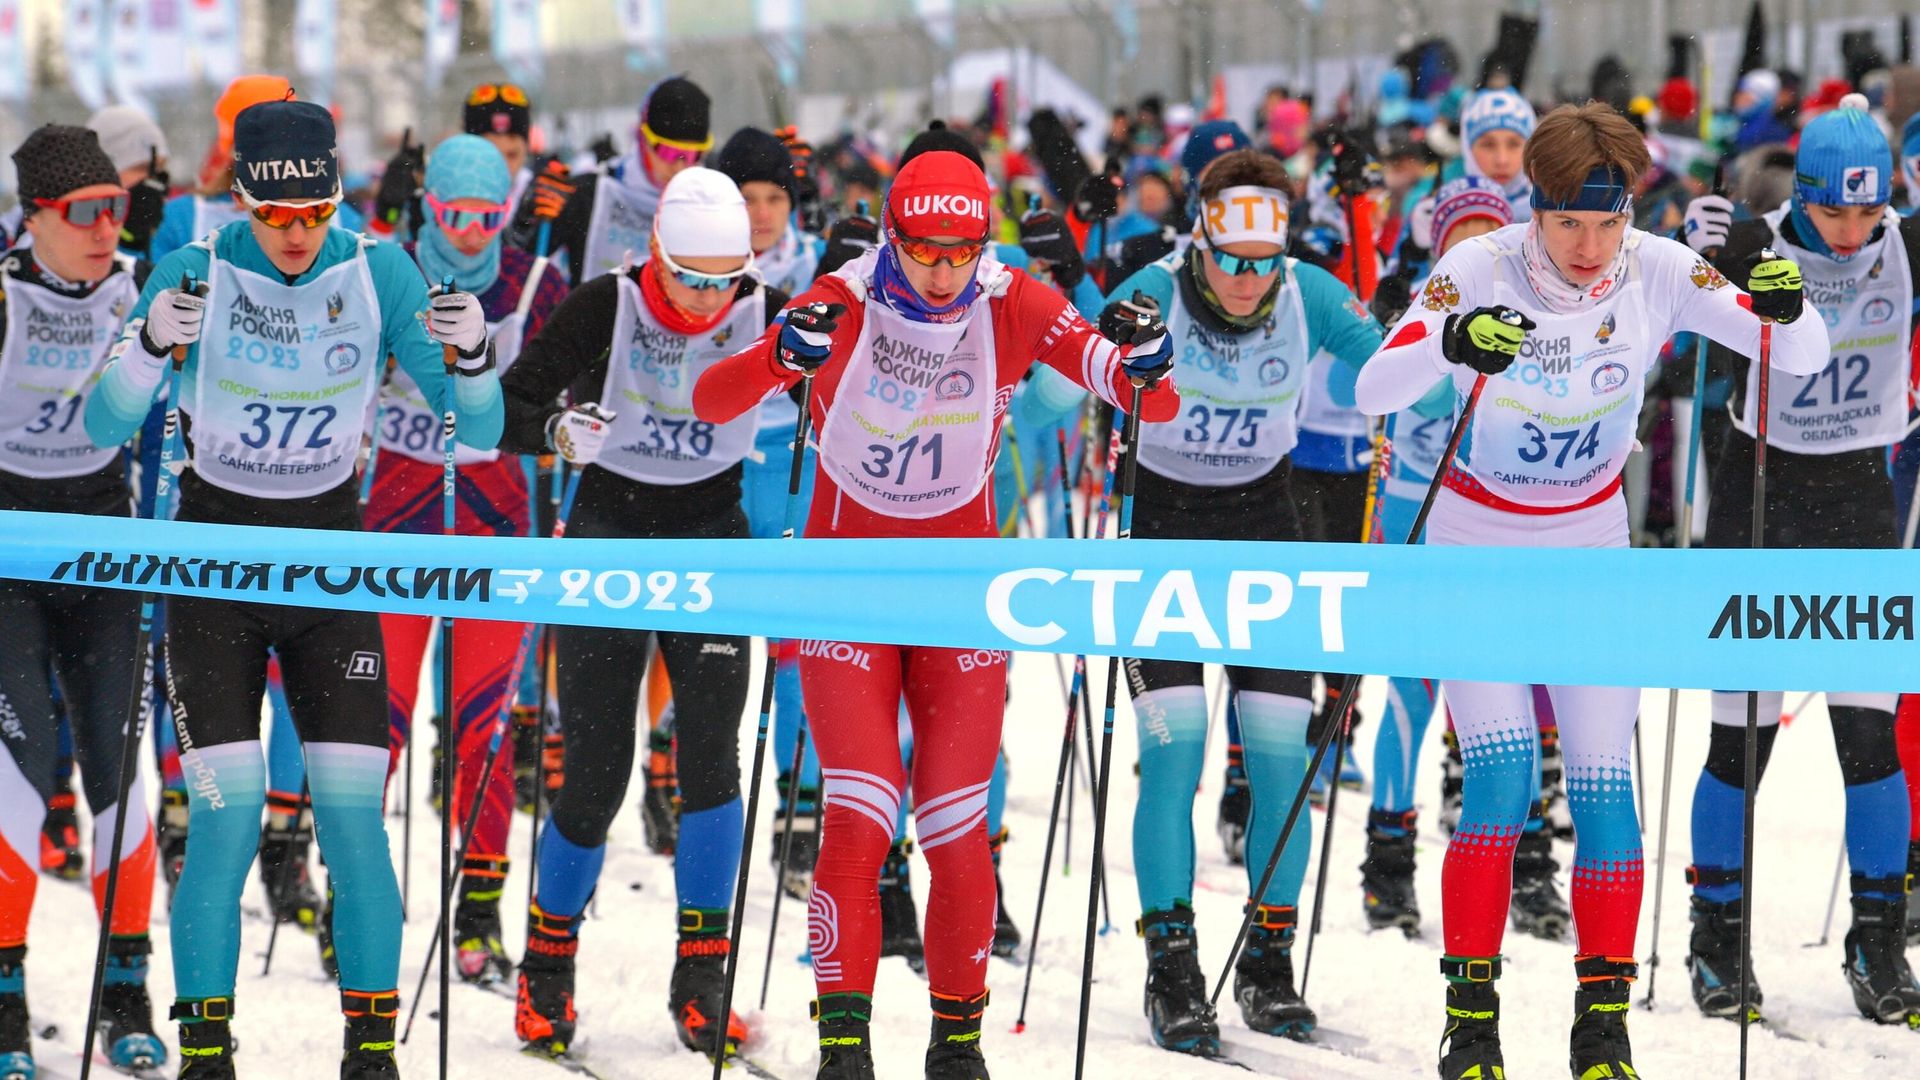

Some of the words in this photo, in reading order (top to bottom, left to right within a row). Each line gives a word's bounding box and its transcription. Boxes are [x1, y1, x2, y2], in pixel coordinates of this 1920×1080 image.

[903, 194, 985, 220] LUKOIL
[25, 345, 92, 370] 2023
[225, 336, 301, 371] 2023
[871, 333, 945, 370] ЛЫЖНЯ
[871, 350, 940, 390] РОССИИ
[1791, 353, 1871, 408] 212
[218, 378, 260, 400] СПОРТ
[240, 402, 338, 450] 372
[930, 411, 981, 426] ЖИЗНИ
[1184, 404, 1268, 448] 375
[1495, 396, 1533, 416] СПОРТ
[1541, 410, 1590, 427] НОРМА
[1779, 404, 1882, 428] ЛЕНИНГРАДСКАЯ
[641, 413, 716, 458] 378
[1517, 420, 1601, 470] 374
[1801, 425, 1858, 442] ОБЛАСТЬ
[1493, 459, 1612, 488] САНКТ-ПЕТЕРБУРГ
[50, 551, 277, 592] ЛЫЖНЯ
[282, 565, 494, 603] РОССИИ
[555, 568, 716, 613] 2023
[985, 567, 1370, 652] СТАРТ
[1707, 594, 1915, 641] ЛЫЖНЯ
[800, 638, 871, 672] LUKOIL
[1589, 1002, 1631, 1012] FISCH
[819, 1037, 862, 1046] SCHER
[946, 1030, 982, 1042] FISC
